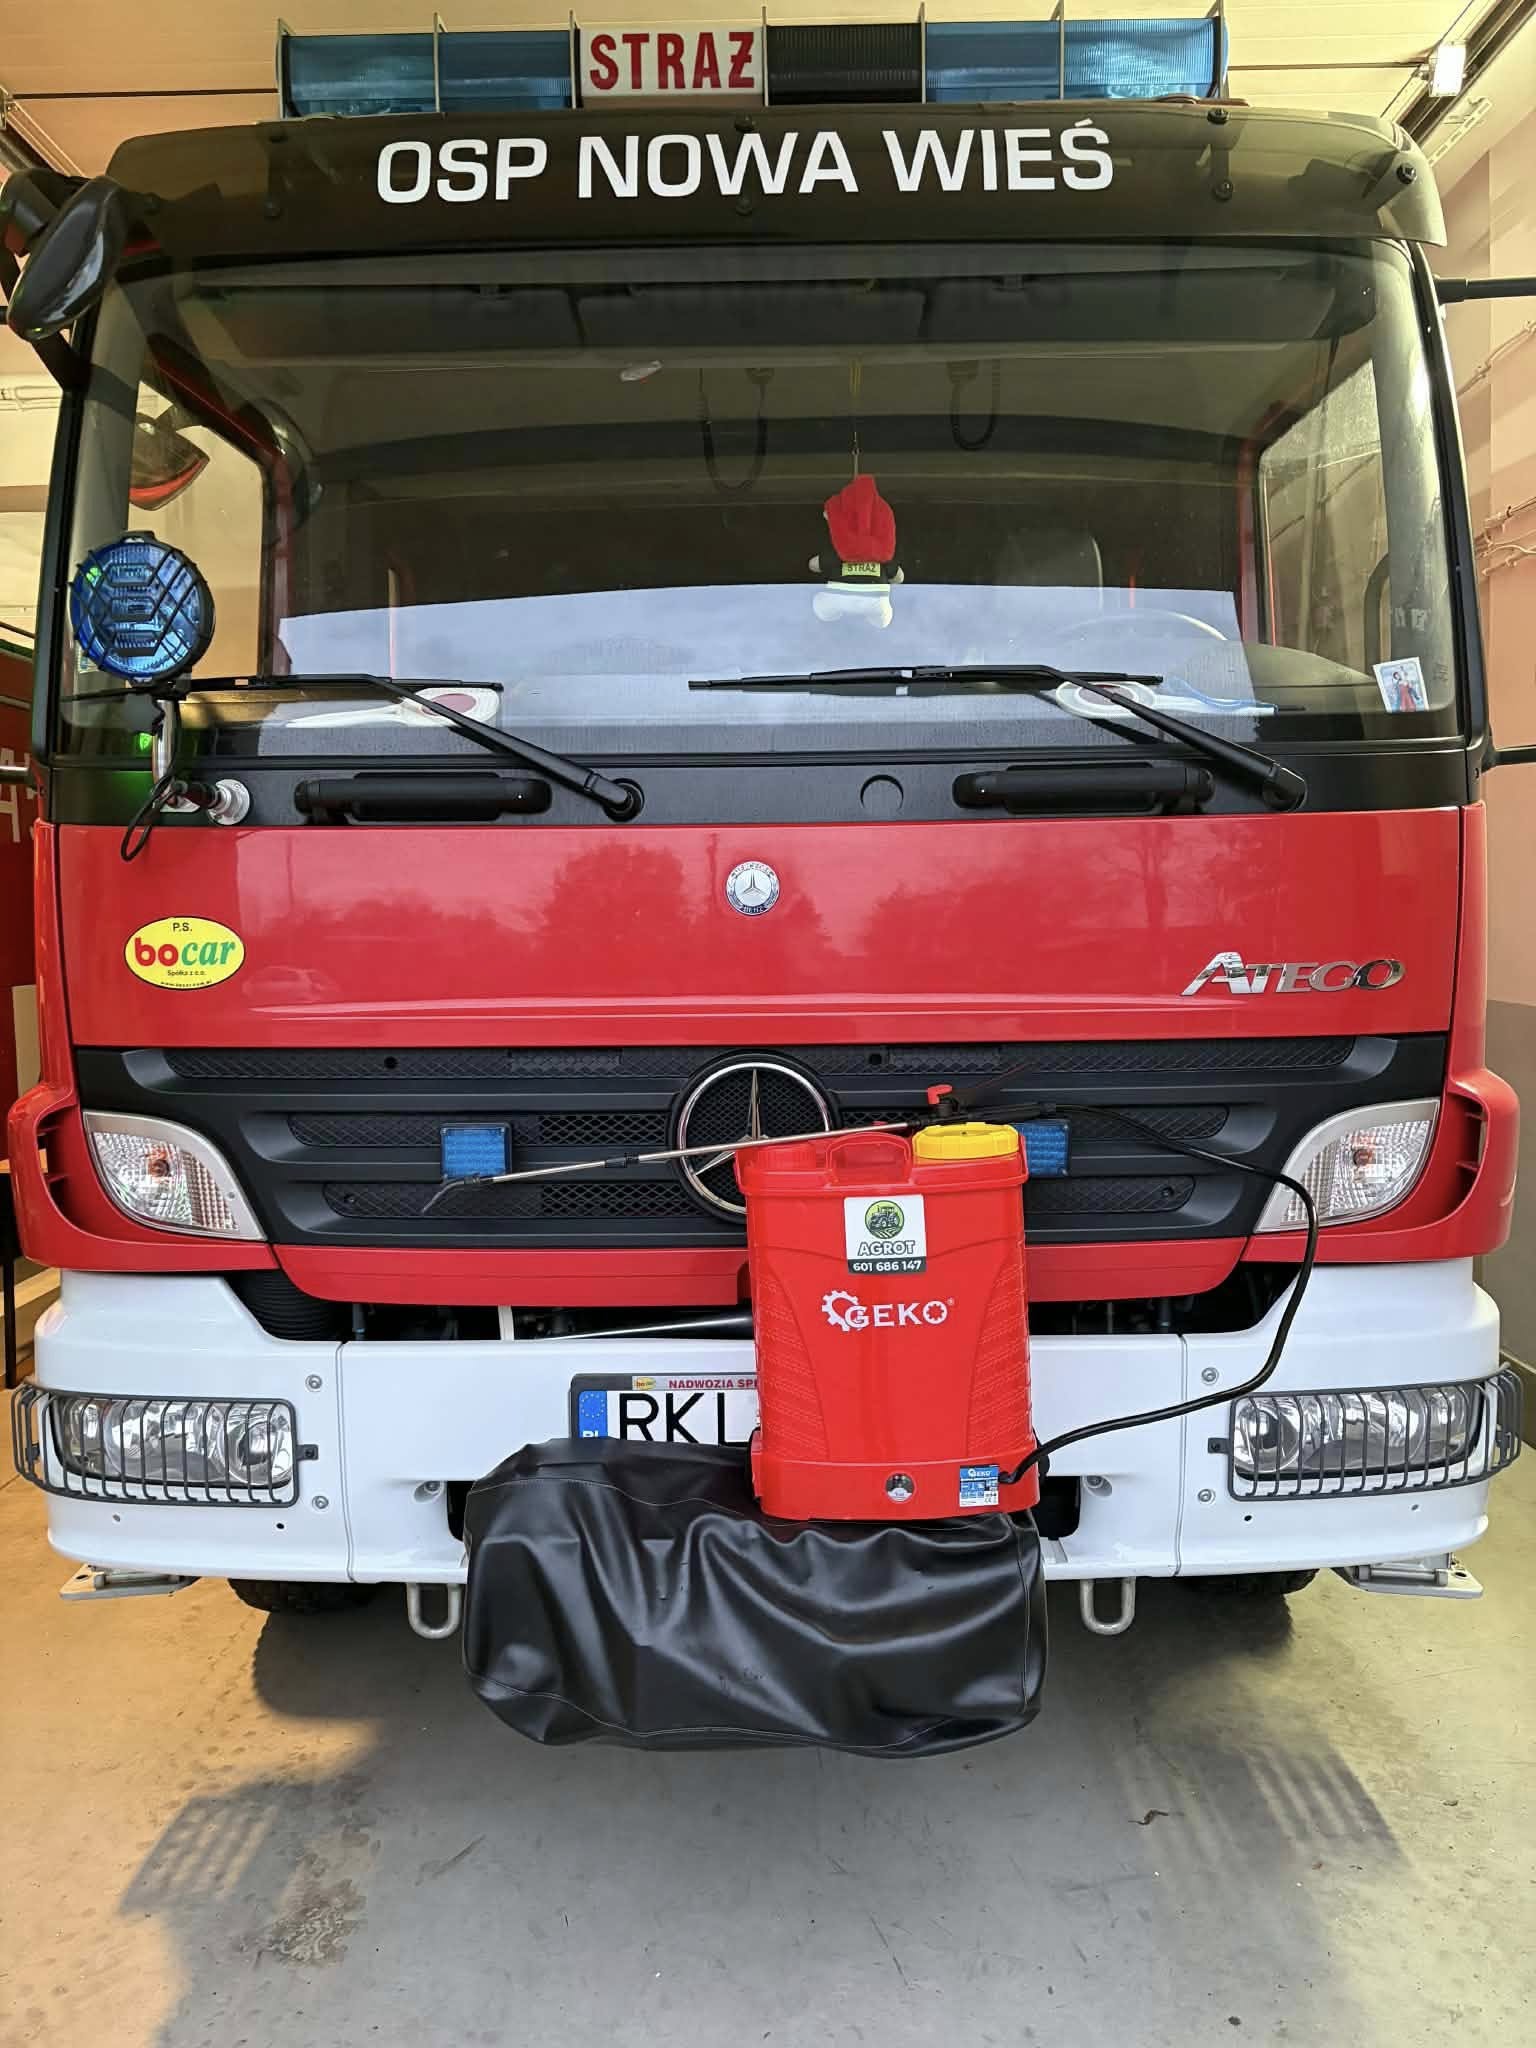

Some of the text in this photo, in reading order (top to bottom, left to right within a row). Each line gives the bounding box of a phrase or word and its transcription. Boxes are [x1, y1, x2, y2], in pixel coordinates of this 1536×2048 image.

[377, 118, 1114, 204] OSP NOWA WIEŚ
[172, 922, 193, 932] P.S.
[134, 937, 236, 967] bocar
[1181, 951, 1406, 996] ATEGO
[857, 1240, 916, 1257] AGROT
[852, 1260, 922, 1272] 601 686 147
[839, 1297, 948, 1330] GEKO
[669, 1379, 733, 1389] NADWOZIA
